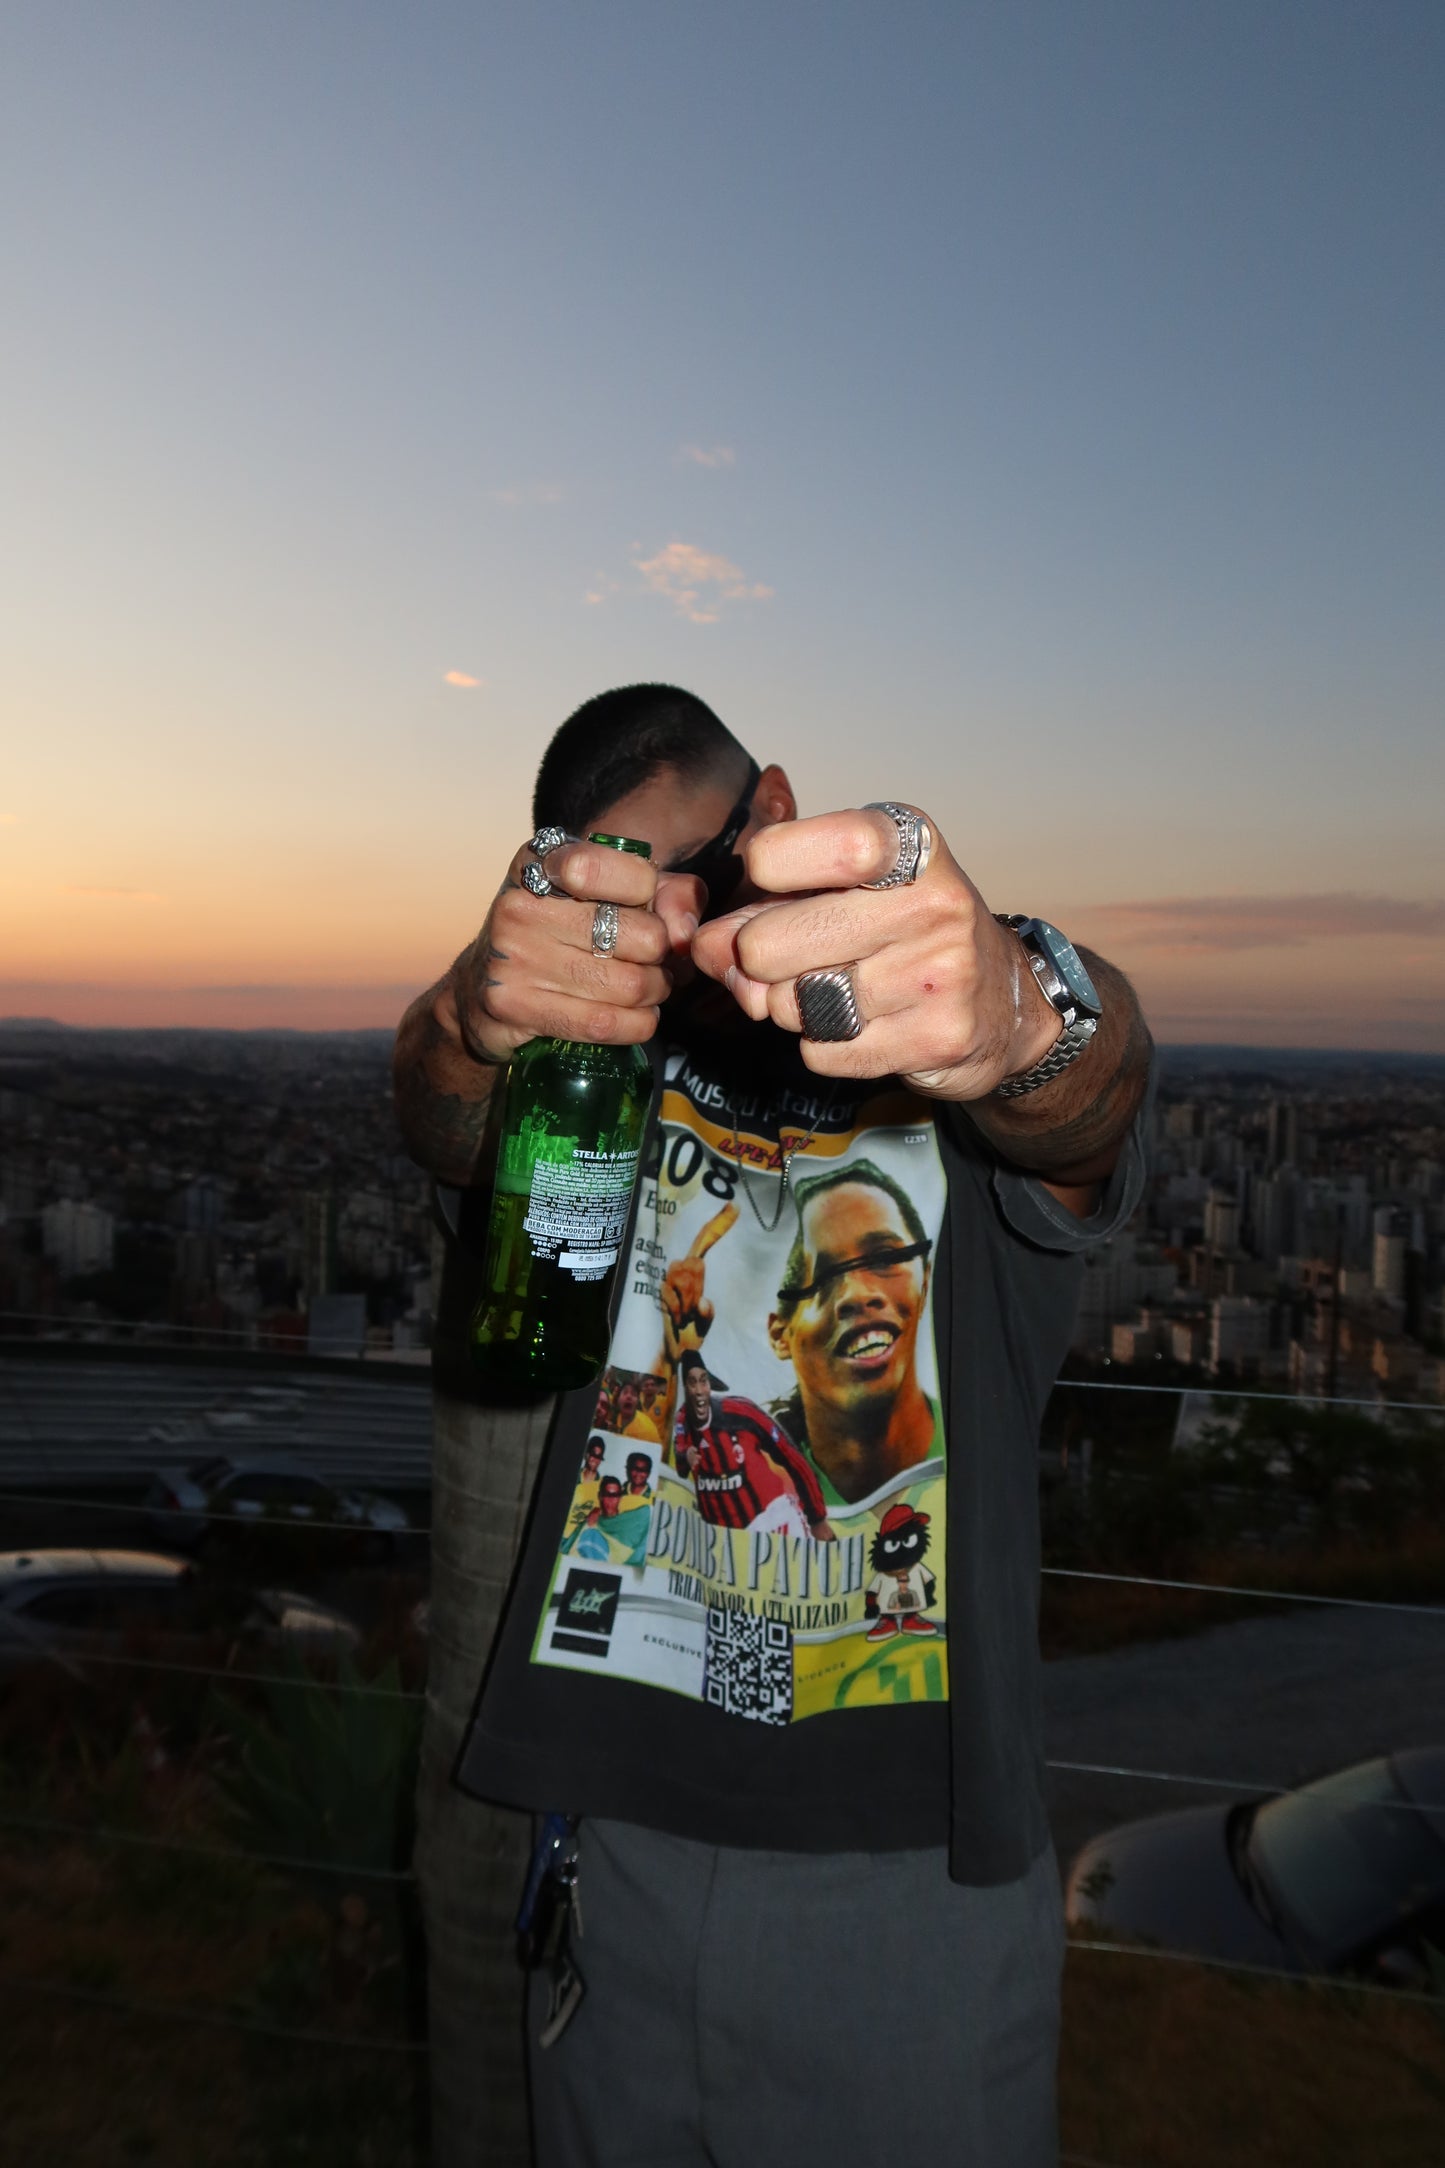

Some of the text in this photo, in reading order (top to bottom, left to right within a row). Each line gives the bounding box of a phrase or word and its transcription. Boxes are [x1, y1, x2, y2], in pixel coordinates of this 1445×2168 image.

[572, 1149, 639, 1160] STELLA ARTOIS
[528, 1219, 545, 1230] BEBA
[546, 1224, 562, 1232] COM
[697, 1473, 743, 1492] bwin
[647, 1499, 864, 1599] BOMBA PATCH
[709, 1588, 755, 1617] ONORA
[762, 1598, 848, 1631] ATUALIZADA
[643, 1634, 703, 1659] EXCLUSIVE
